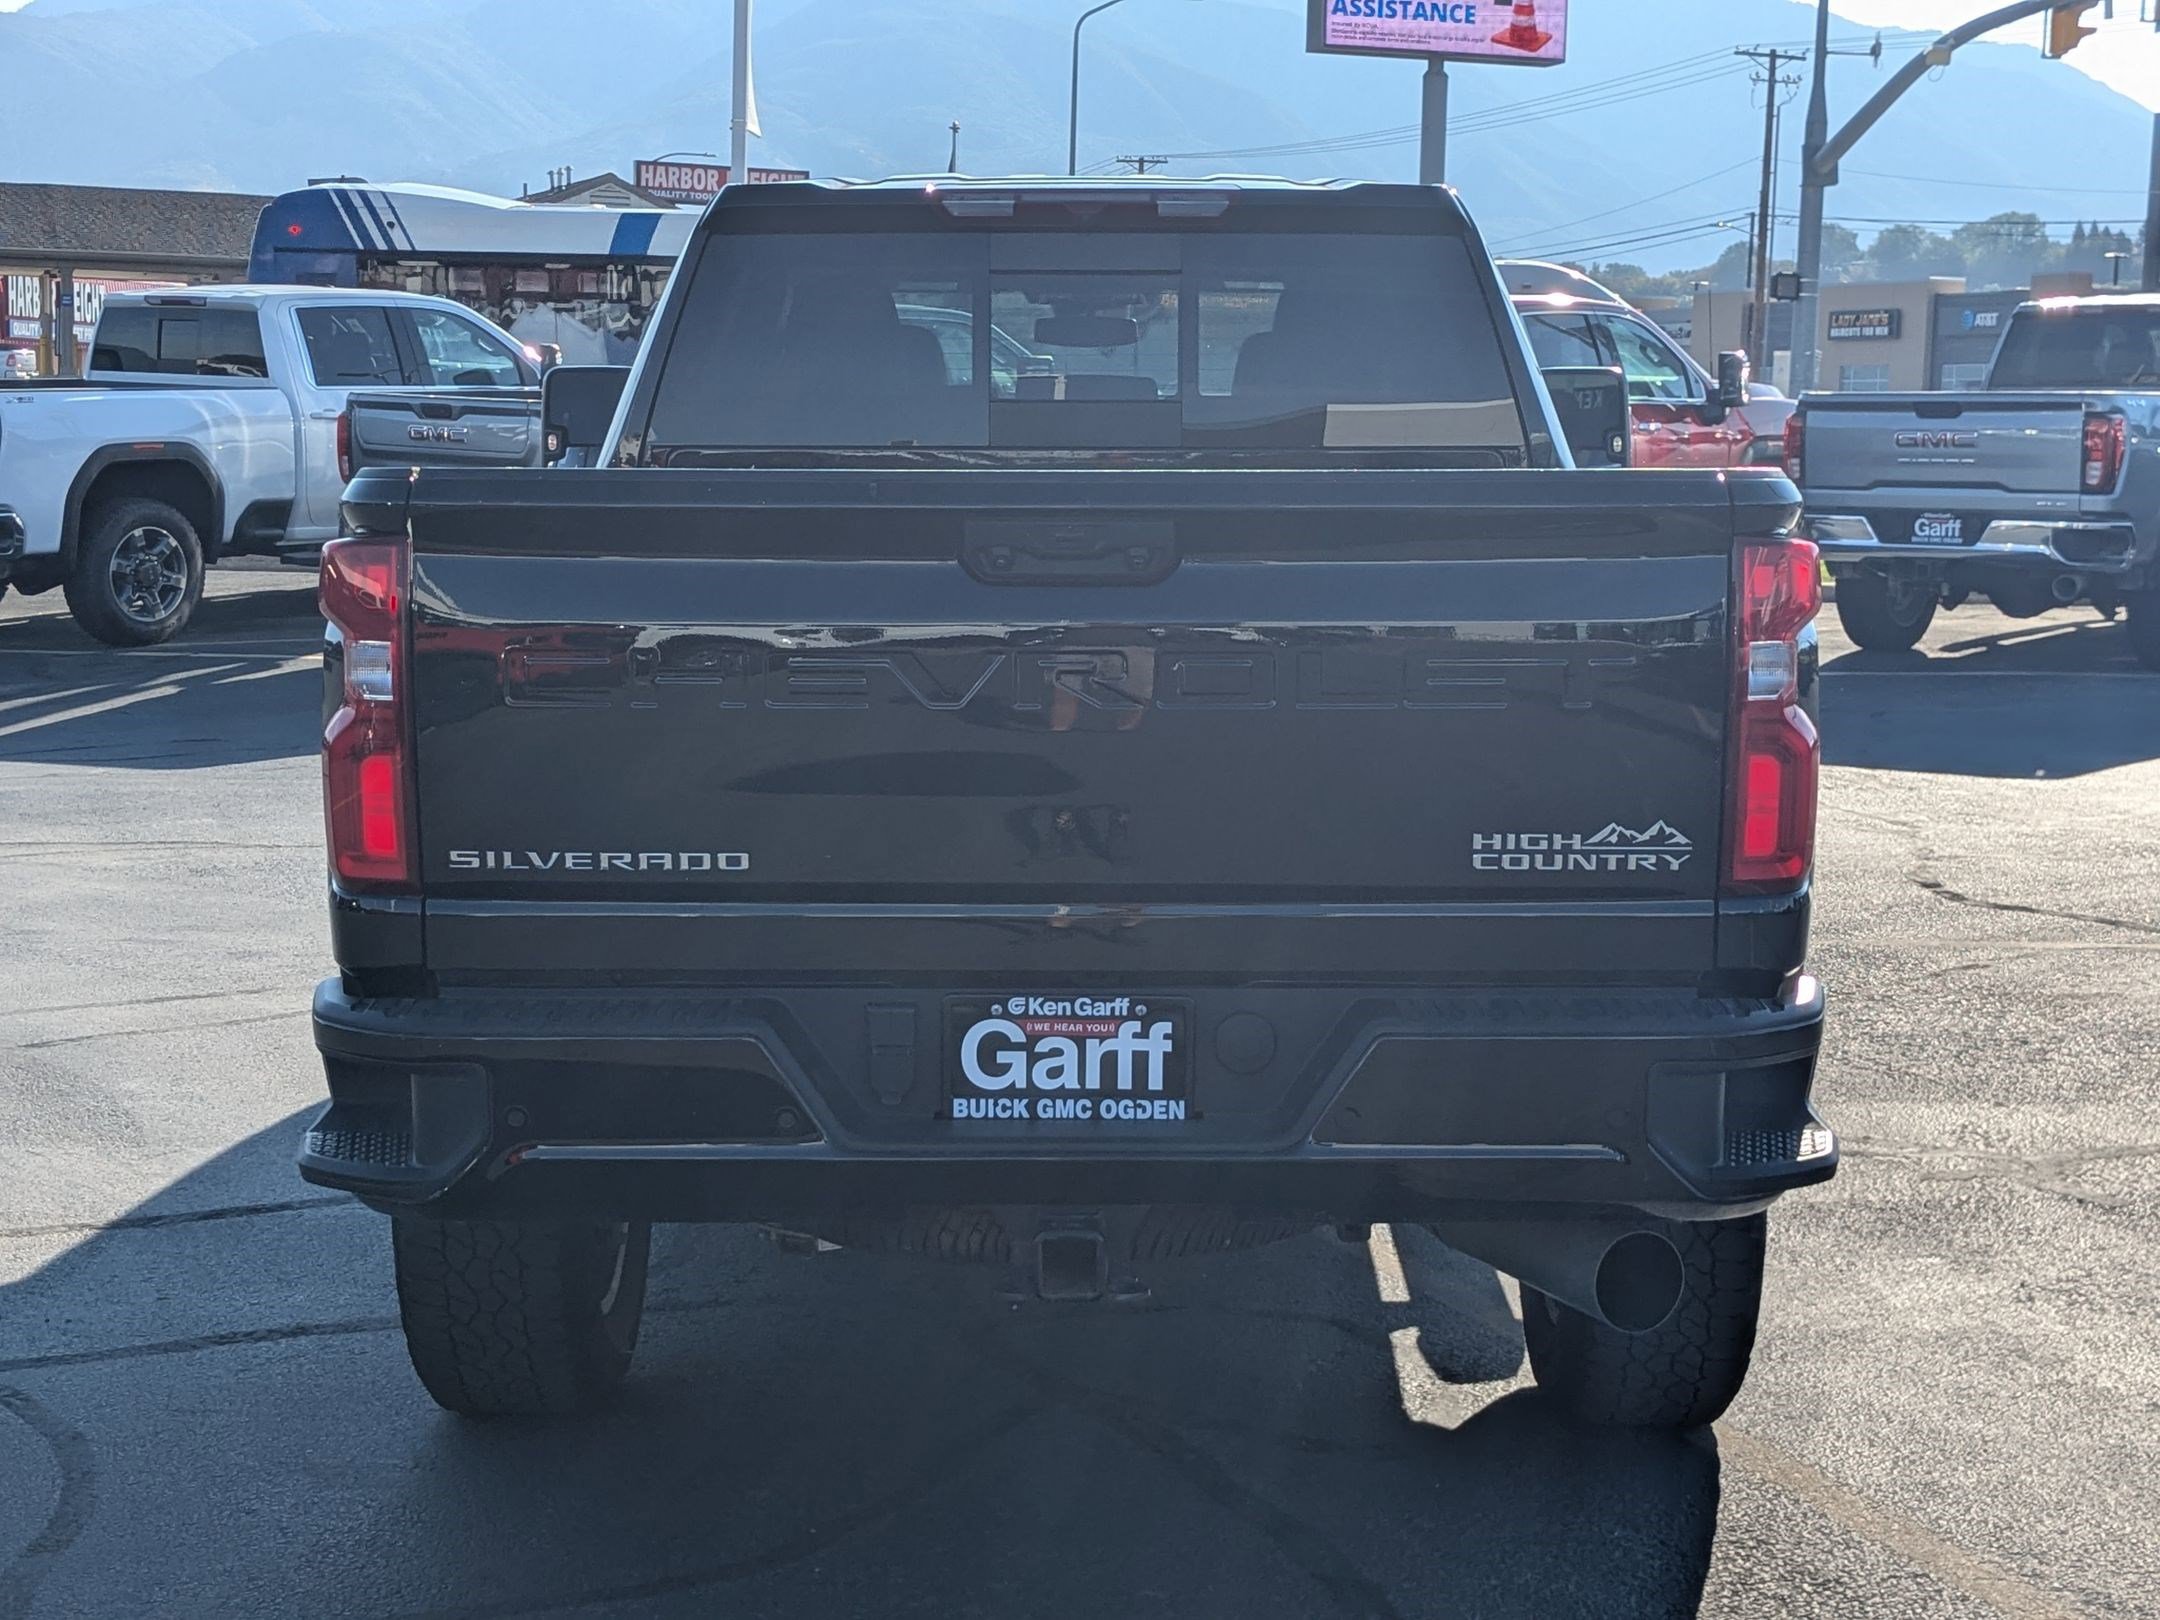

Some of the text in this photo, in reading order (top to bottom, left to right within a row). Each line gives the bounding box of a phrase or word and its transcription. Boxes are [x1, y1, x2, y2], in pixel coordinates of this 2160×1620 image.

[1331, 0, 1476, 24] ASSISTANCE
[640, 165, 720, 191] HARBOR
[1974, 312, 1999, 327] AT&T
[407, 424, 468, 442] GMC
[1894, 430, 1978, 449] GMC
[1914, 518, 1962, 537] Garff
[501, 646, 1637, 710] CHEVROLET
[1472, 833, 1582, 850] HIGH
[449, 850, 750, 871] SILVERADO
[1472, 854, 1691, 871] COUNTRY
[1028, 998, 1130, 1016] Ken Garff
[1034, 1022, 1108, 1032] WE HEAR YOU
[960, 1018, 1173, 1091] Garff
[953, 1098, 1185, 1120] BUICK GMC OGDEN
